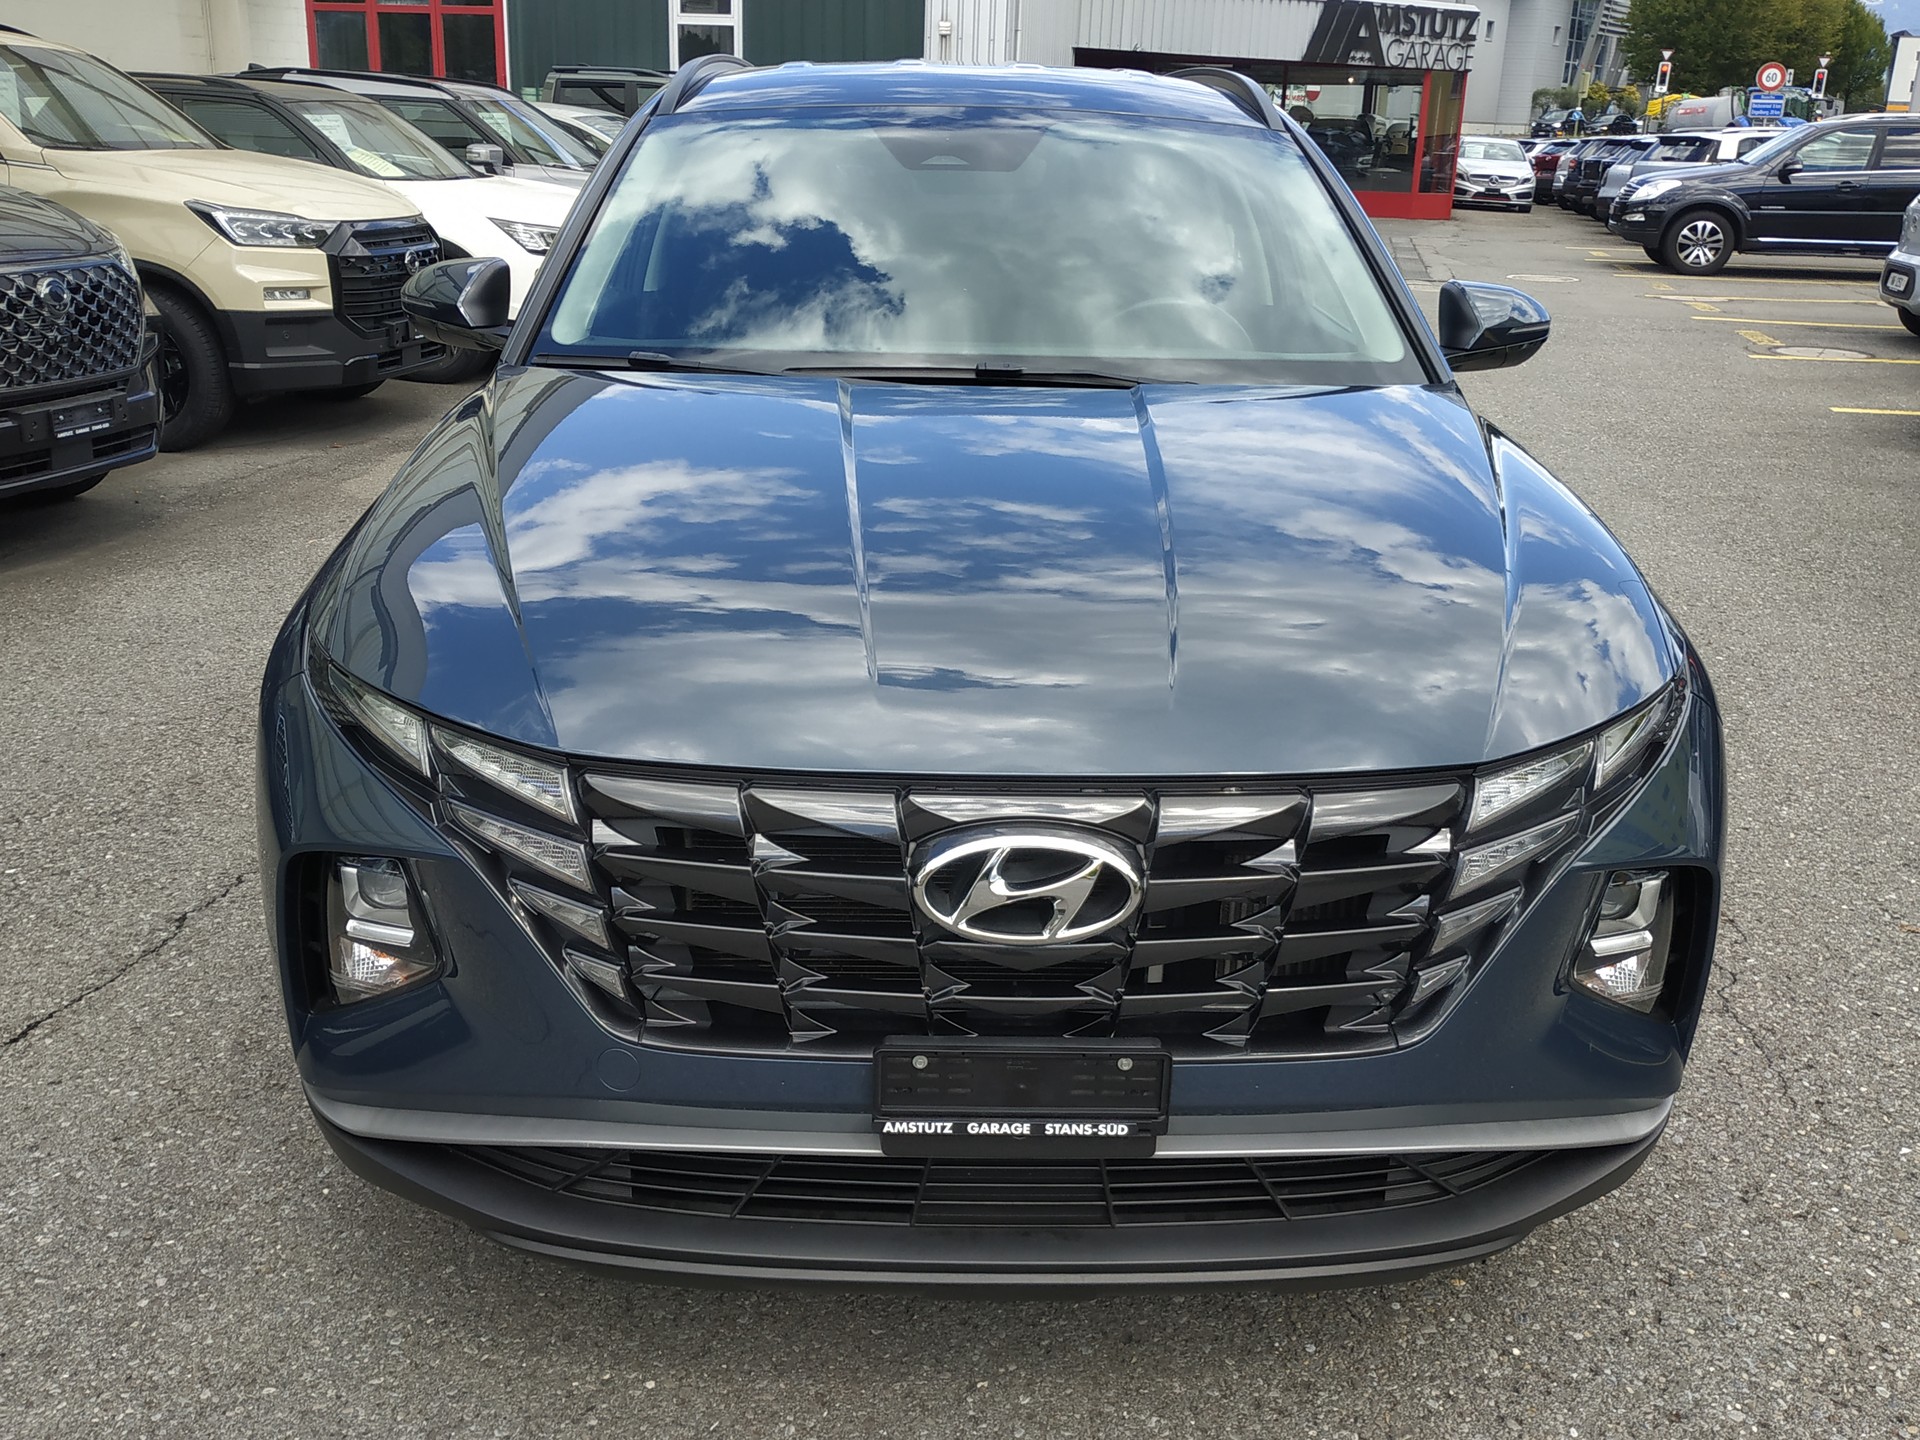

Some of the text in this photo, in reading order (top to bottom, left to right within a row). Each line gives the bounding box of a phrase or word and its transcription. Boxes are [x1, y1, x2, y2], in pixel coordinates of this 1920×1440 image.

[1336, 1, 1480, 66] AMSTUTZ
[1386, 39, 1476, 72] GARAGE
[1765, 72, 1778, 83] 60
[882, 1122, 1129, 1136] AMSTUTZ GARAGE STANS-SÜD
